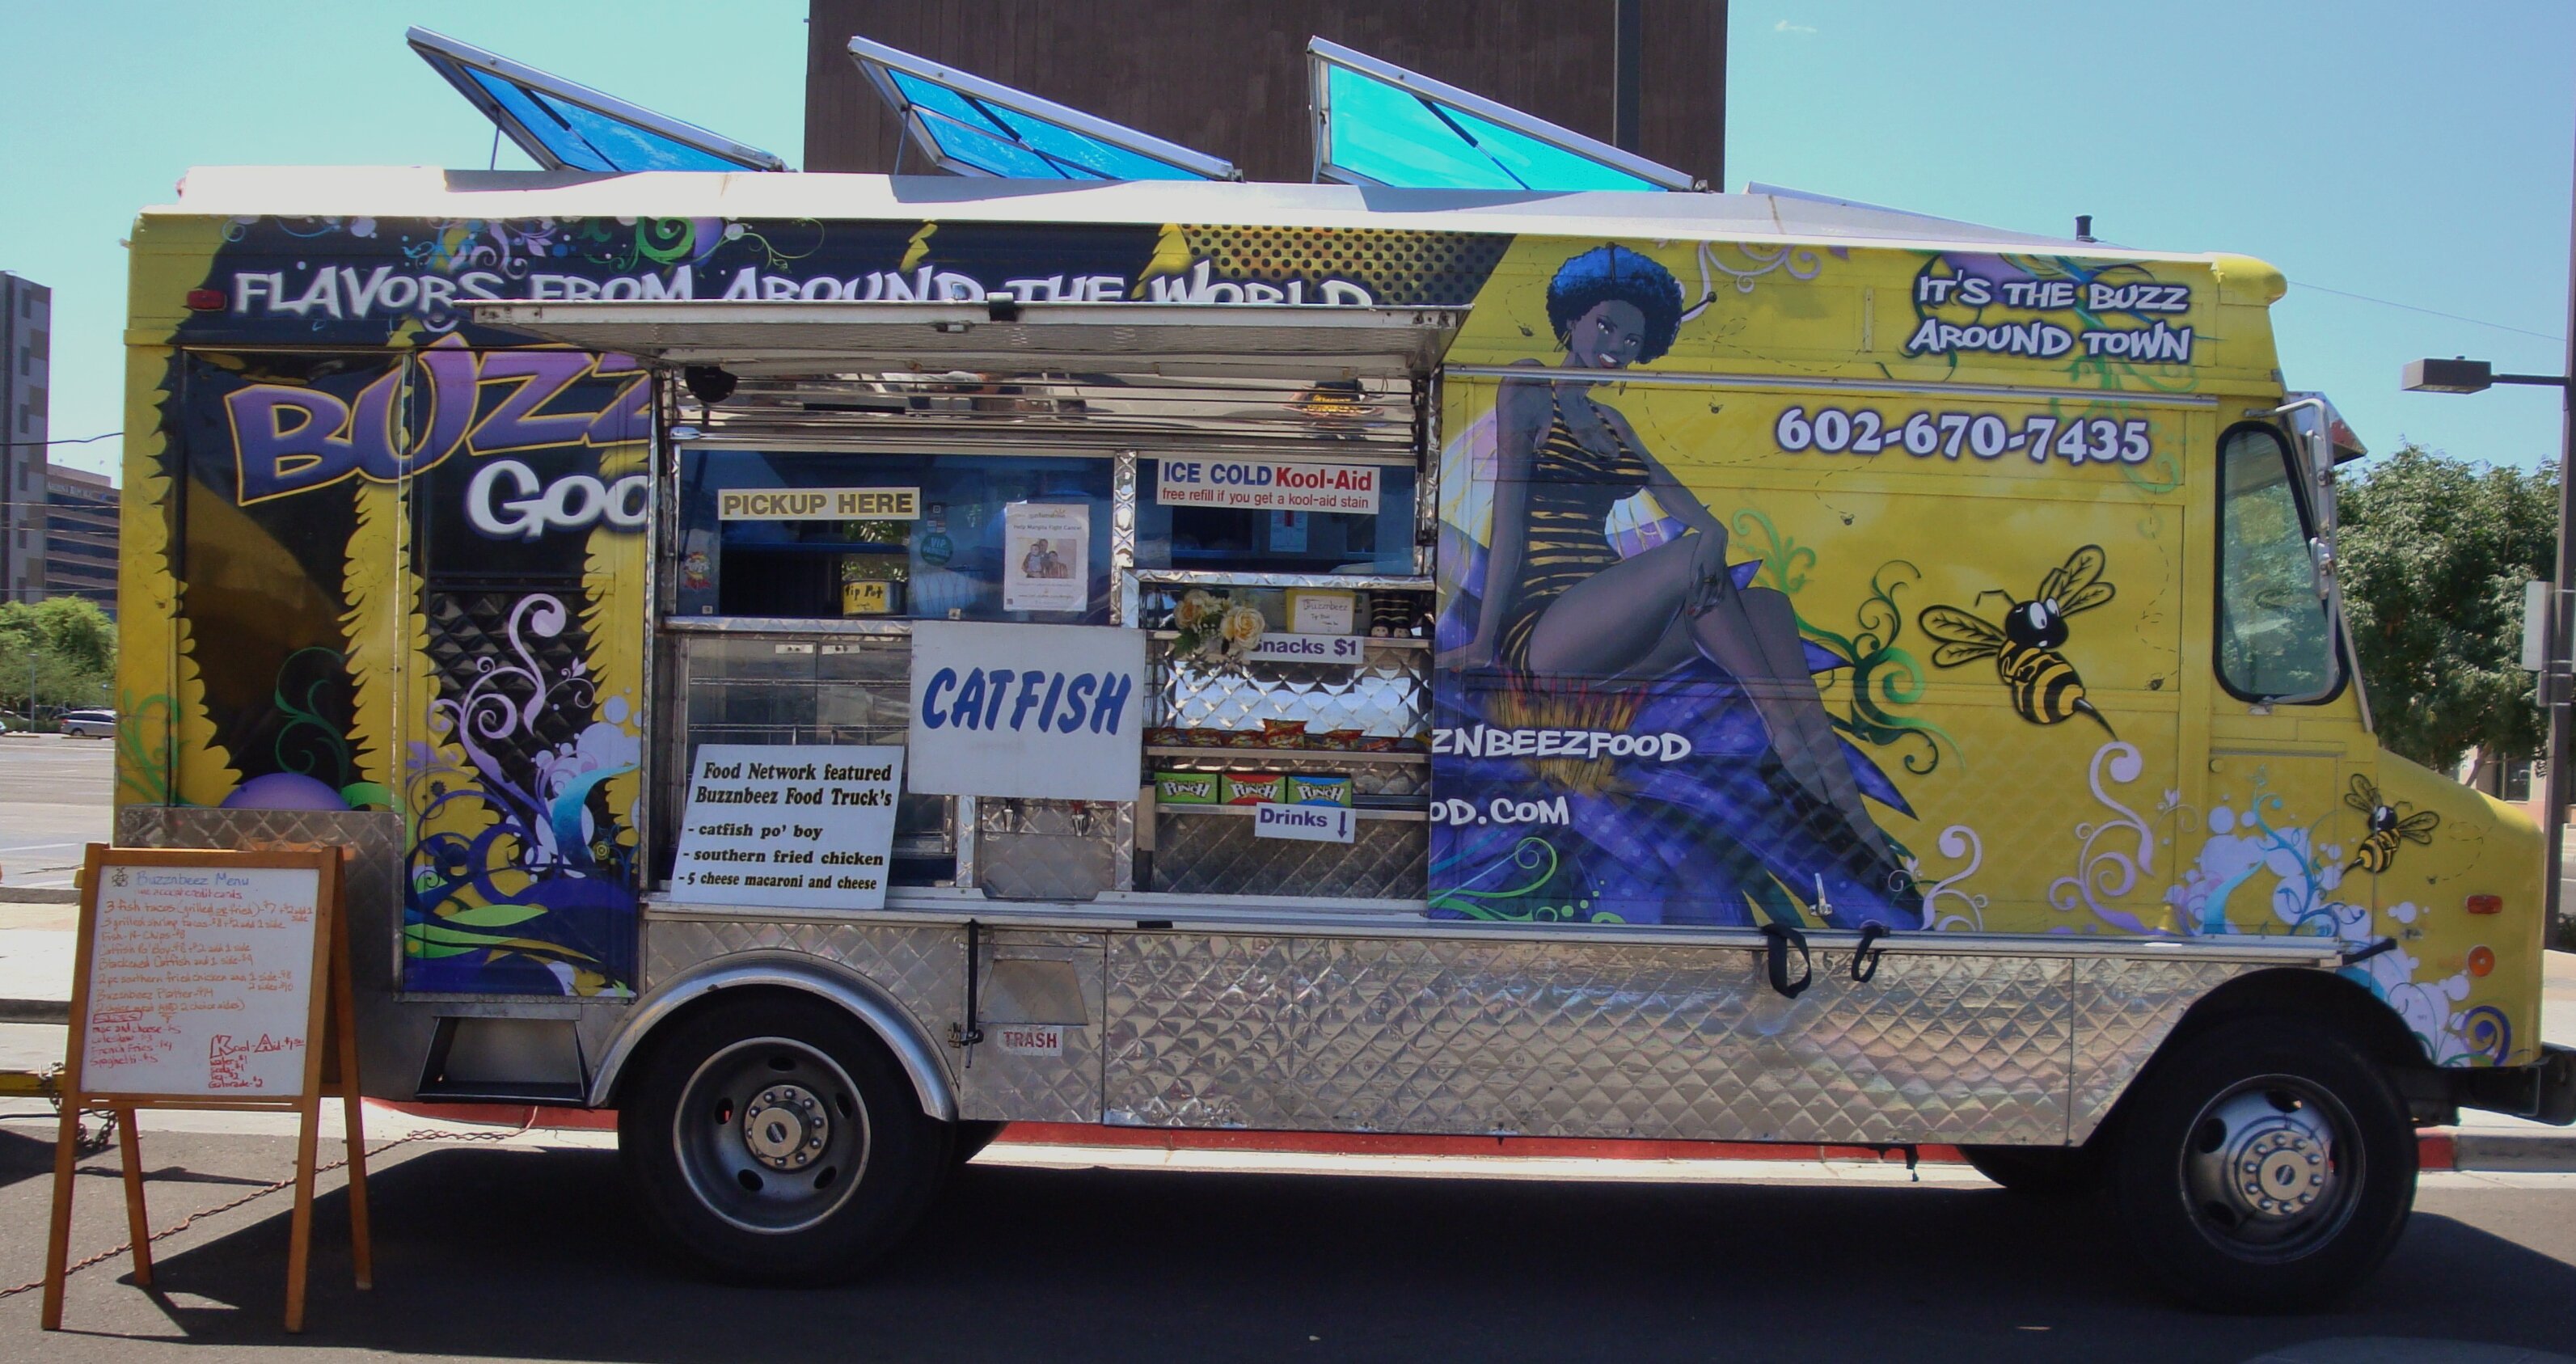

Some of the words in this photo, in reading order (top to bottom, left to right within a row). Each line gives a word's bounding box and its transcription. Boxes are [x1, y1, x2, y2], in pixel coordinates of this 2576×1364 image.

[234, 266, 504, 321] FLAVORS
[529, 264, 693, 301] FROM
[1916, 269, 1991, 305] IT'S
[2003, 281, 2076, 309] THE
[2088, 285, 2189, 311] BUZZ
[1908, 319, 2072, 357] AROUND
[2081, 322, 2193, 364] TOWN
[1777, 407, 2151, 464] 602-670-7435
[1163, 462, 1201, 484] ICE
[1210, 464, 1272, 486] COLD
[1276, 467, 1372, 492] Kool-Aid
[724, 493, 827, 516] PICKUP
[837, 492, 914, 514] HERE
[1163, 488, 1185, 500] free
[1189, 488, 1214, 501] refill
[1217, 489, 1226, 502] if
[1229, 493, 1251, 505] you
[1255, 492, 1273, 506] get
[1277, 495, 1284, 505] a
[1288, 492, 1337, 507] kool-aid
[1341, 495, 1369, 509] stain
[1333, 638, 1356, 657] $1
[922, 665, 1132, 735] CATFISH
[703, 762, 741, 780] Food
[748, 763, 817, 781] Network
[824, 764, 893, 783] featured
[695, 786, 778, 805] Buzznbeez
[785, 788, 824, 806] Food
[830, 788, 893, 807] Truck's
[1163, 780, 1211, 798] PUNCH
[1230, 781, 1278, 800] PUNCH
[1297, 783, 1345, 801] PUNCH
[1260, 809, 1328, 827] Drinks
[699, 822, 753, 838] catfish
[761, 825, 787, 841] po'
[793, 824, 823, 841] boy
[693, 848, 766, 864] southern
[774, 849, 813, 864] fried
[821, 850, 884, 866] chicken
[216, 872, 249, 885] Menu
[700, 872, 740, 886] cheese
[745, 873, 803, 889] macaroni
[809, 874, 832, 889] and
[837, 876, 877, 890] cheese
[103, 901, 115, 913] 3
[116, 898, 141, 911] fish
[145, 903, 176, 913] tacos
[1003, 1031, 1057, 1048] TRASH
